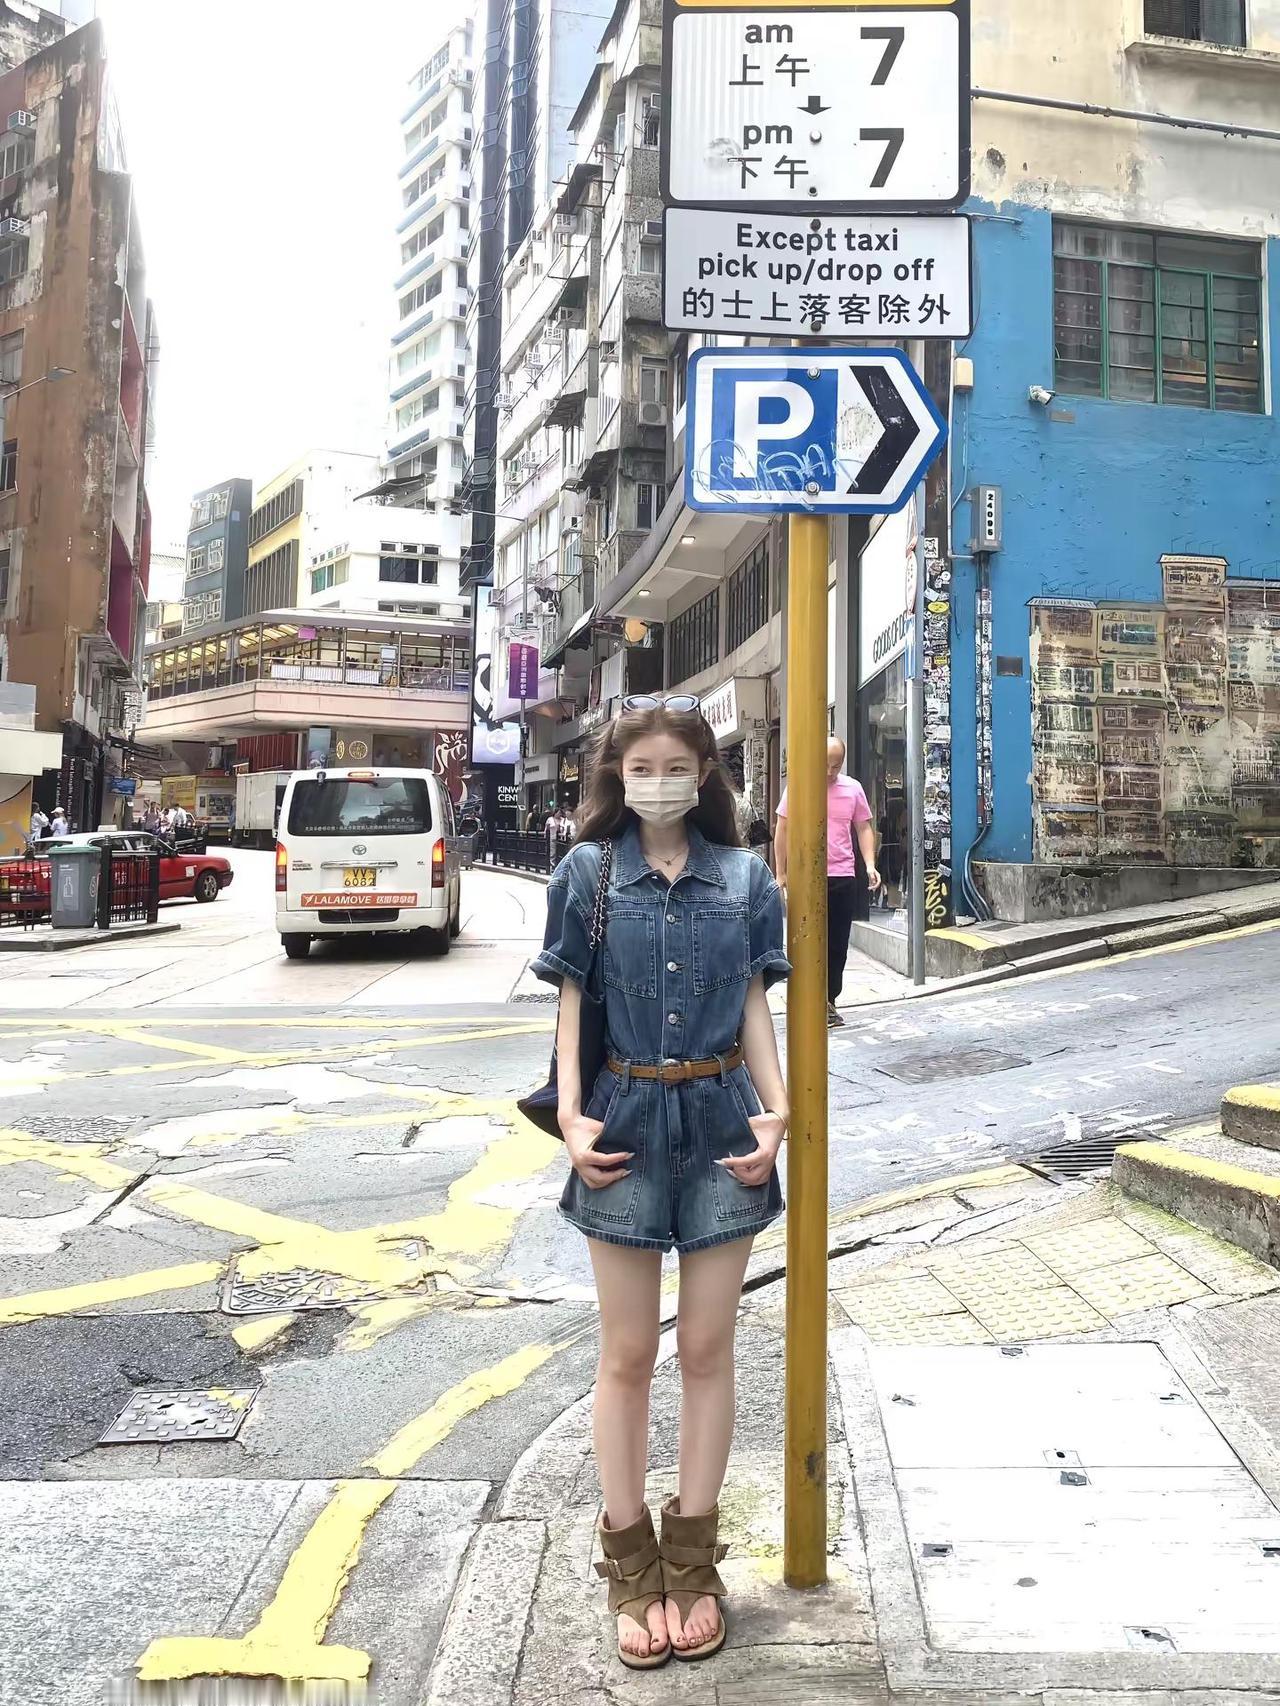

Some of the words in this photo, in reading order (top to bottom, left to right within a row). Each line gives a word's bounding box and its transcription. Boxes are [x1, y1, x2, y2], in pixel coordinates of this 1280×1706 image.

[728, 54, 810, 87] 上午
[745, 24, 793, 43] am
[860, 26, 905, 86] 7
[727, 155, 809, 189] 下午
[743, 124, 793, 150] pm
[859, 128, 905, 188] 7
[737, 223, 836, 256] Except
[844, 227, 899, 251] taxi
[698, 252, 758, 279] pick
[768, 257, 883, 285] up/drop
[893, 258, 935, 281] off
[682, 286, 951, 325] 的士上落客除外
[734, 380, 815, 479] P
[497, 785, 519, 794] KINW
[497, 793, 518, 802] CENT
[315, 894, 371, 905] LALAMOVE
